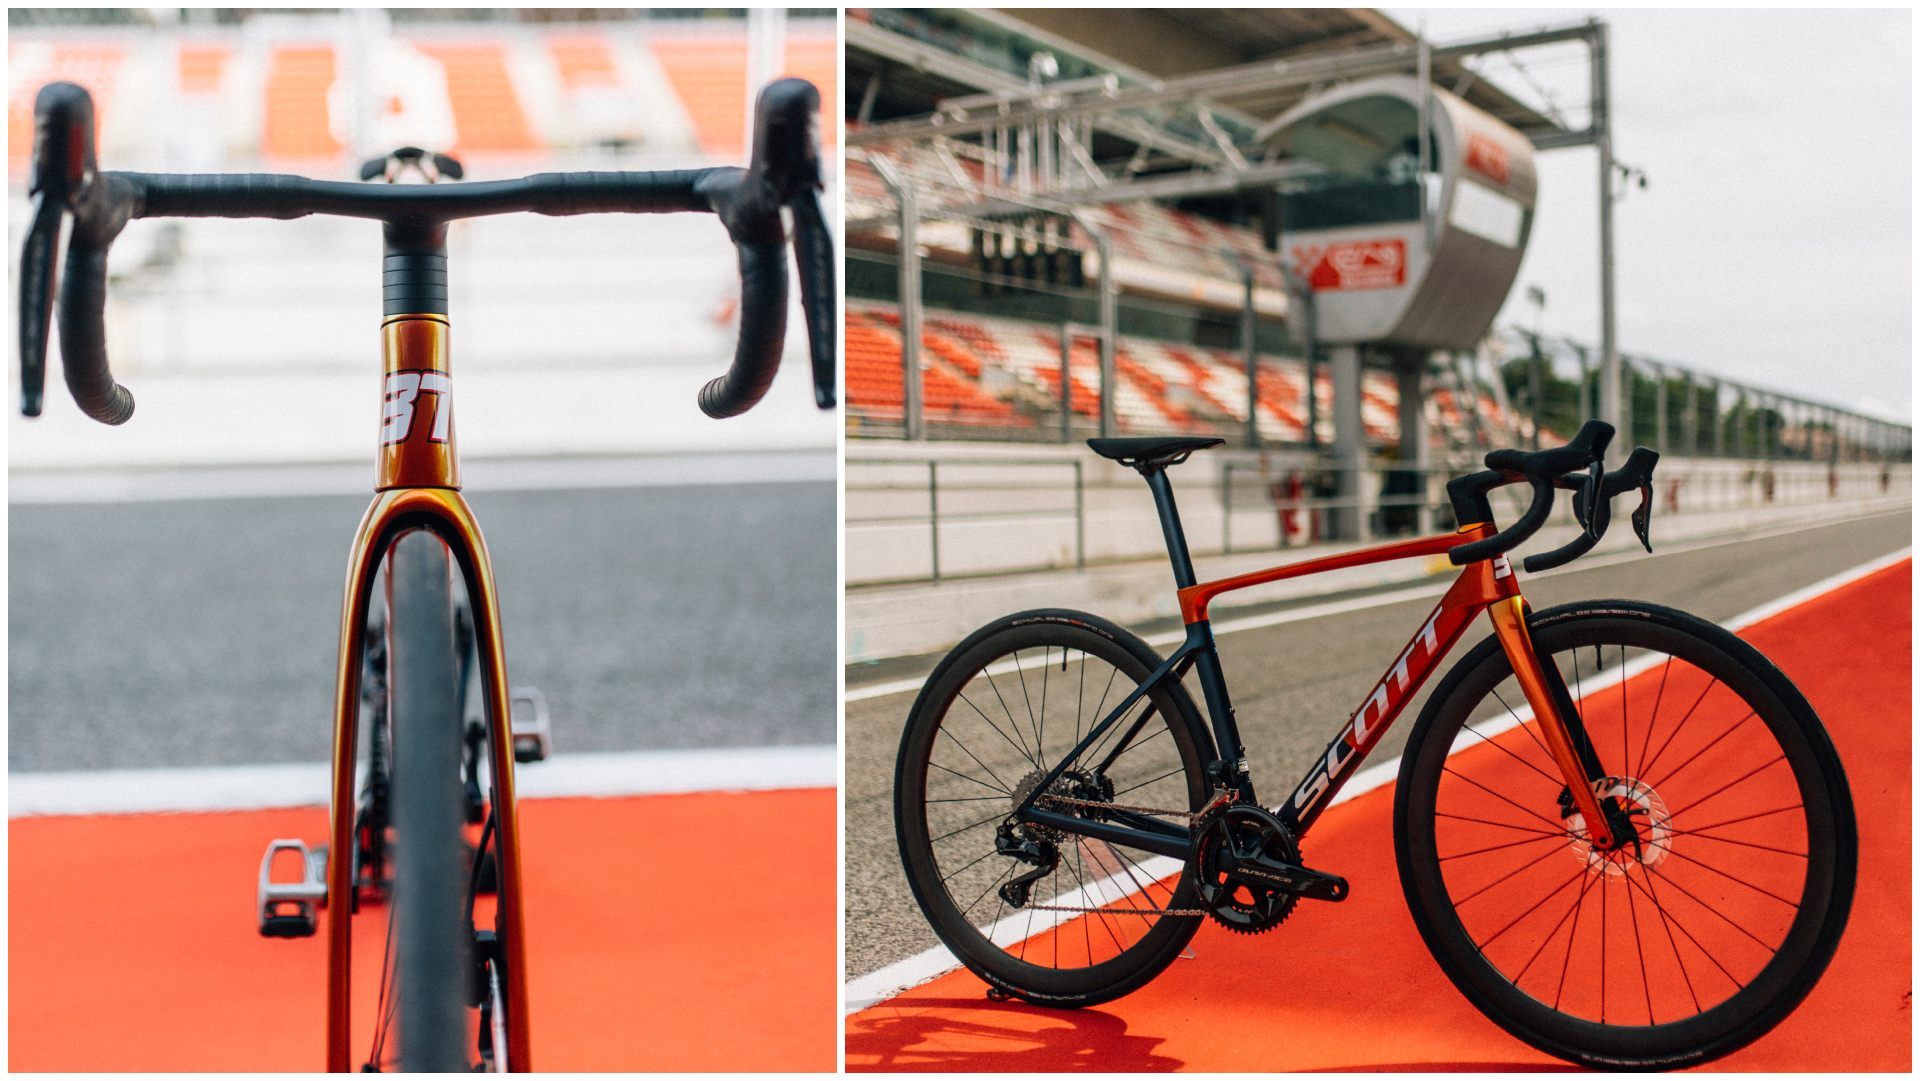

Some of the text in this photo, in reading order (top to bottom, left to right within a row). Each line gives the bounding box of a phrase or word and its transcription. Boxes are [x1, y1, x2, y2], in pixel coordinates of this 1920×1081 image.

[382, 369, 451, 446] 37
[1531, 610, 1590, 627] SCHWALBE
[1294, 605, 1443, 823] SCOTT
